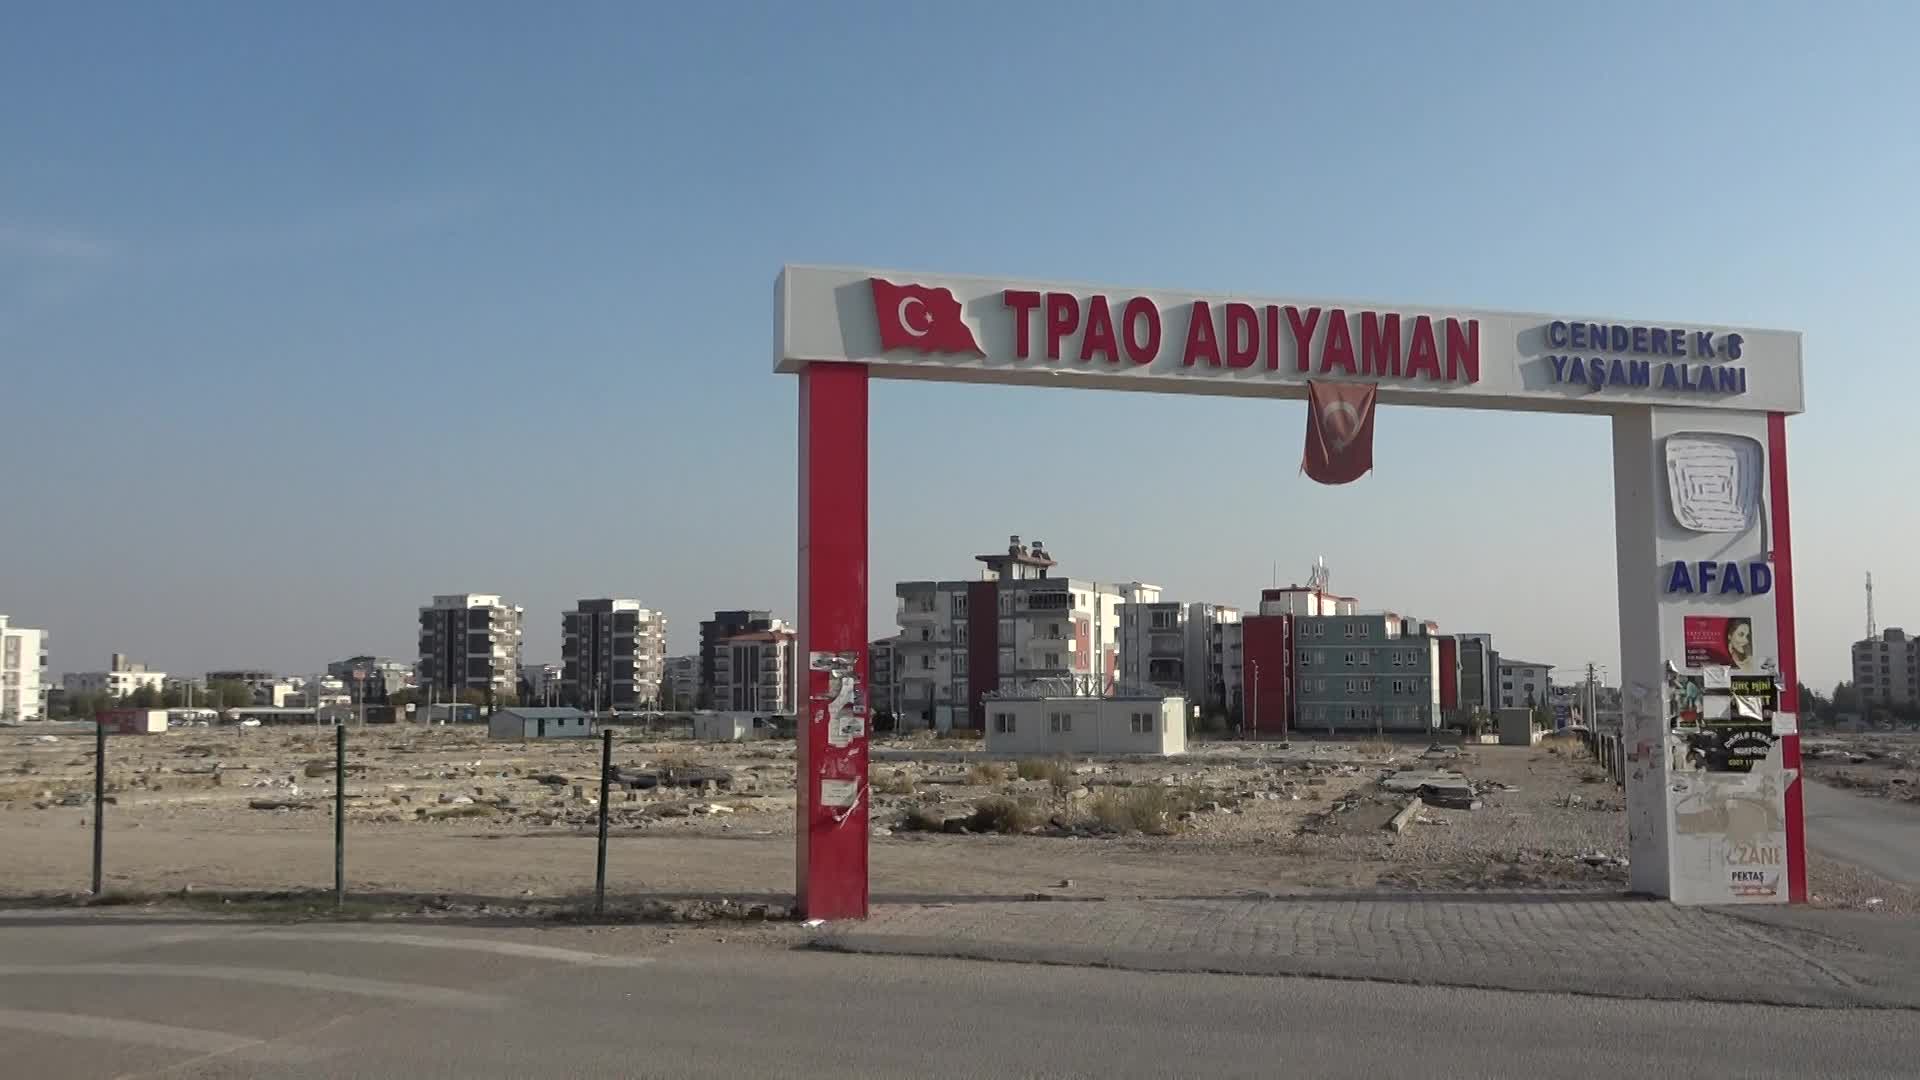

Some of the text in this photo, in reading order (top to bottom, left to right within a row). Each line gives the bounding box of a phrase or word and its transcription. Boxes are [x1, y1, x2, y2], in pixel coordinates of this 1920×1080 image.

[1002, 289, 1480, 383] TPAO ADIYAMAN
[1550, 320, 1687, 356] CENDERE
[1549, 355, 1747, 393] YAŞAM ALANI
[1668, 560, 1773, 594] AFAD
[1731, 871, 1764, 884] PEKTAŞ
